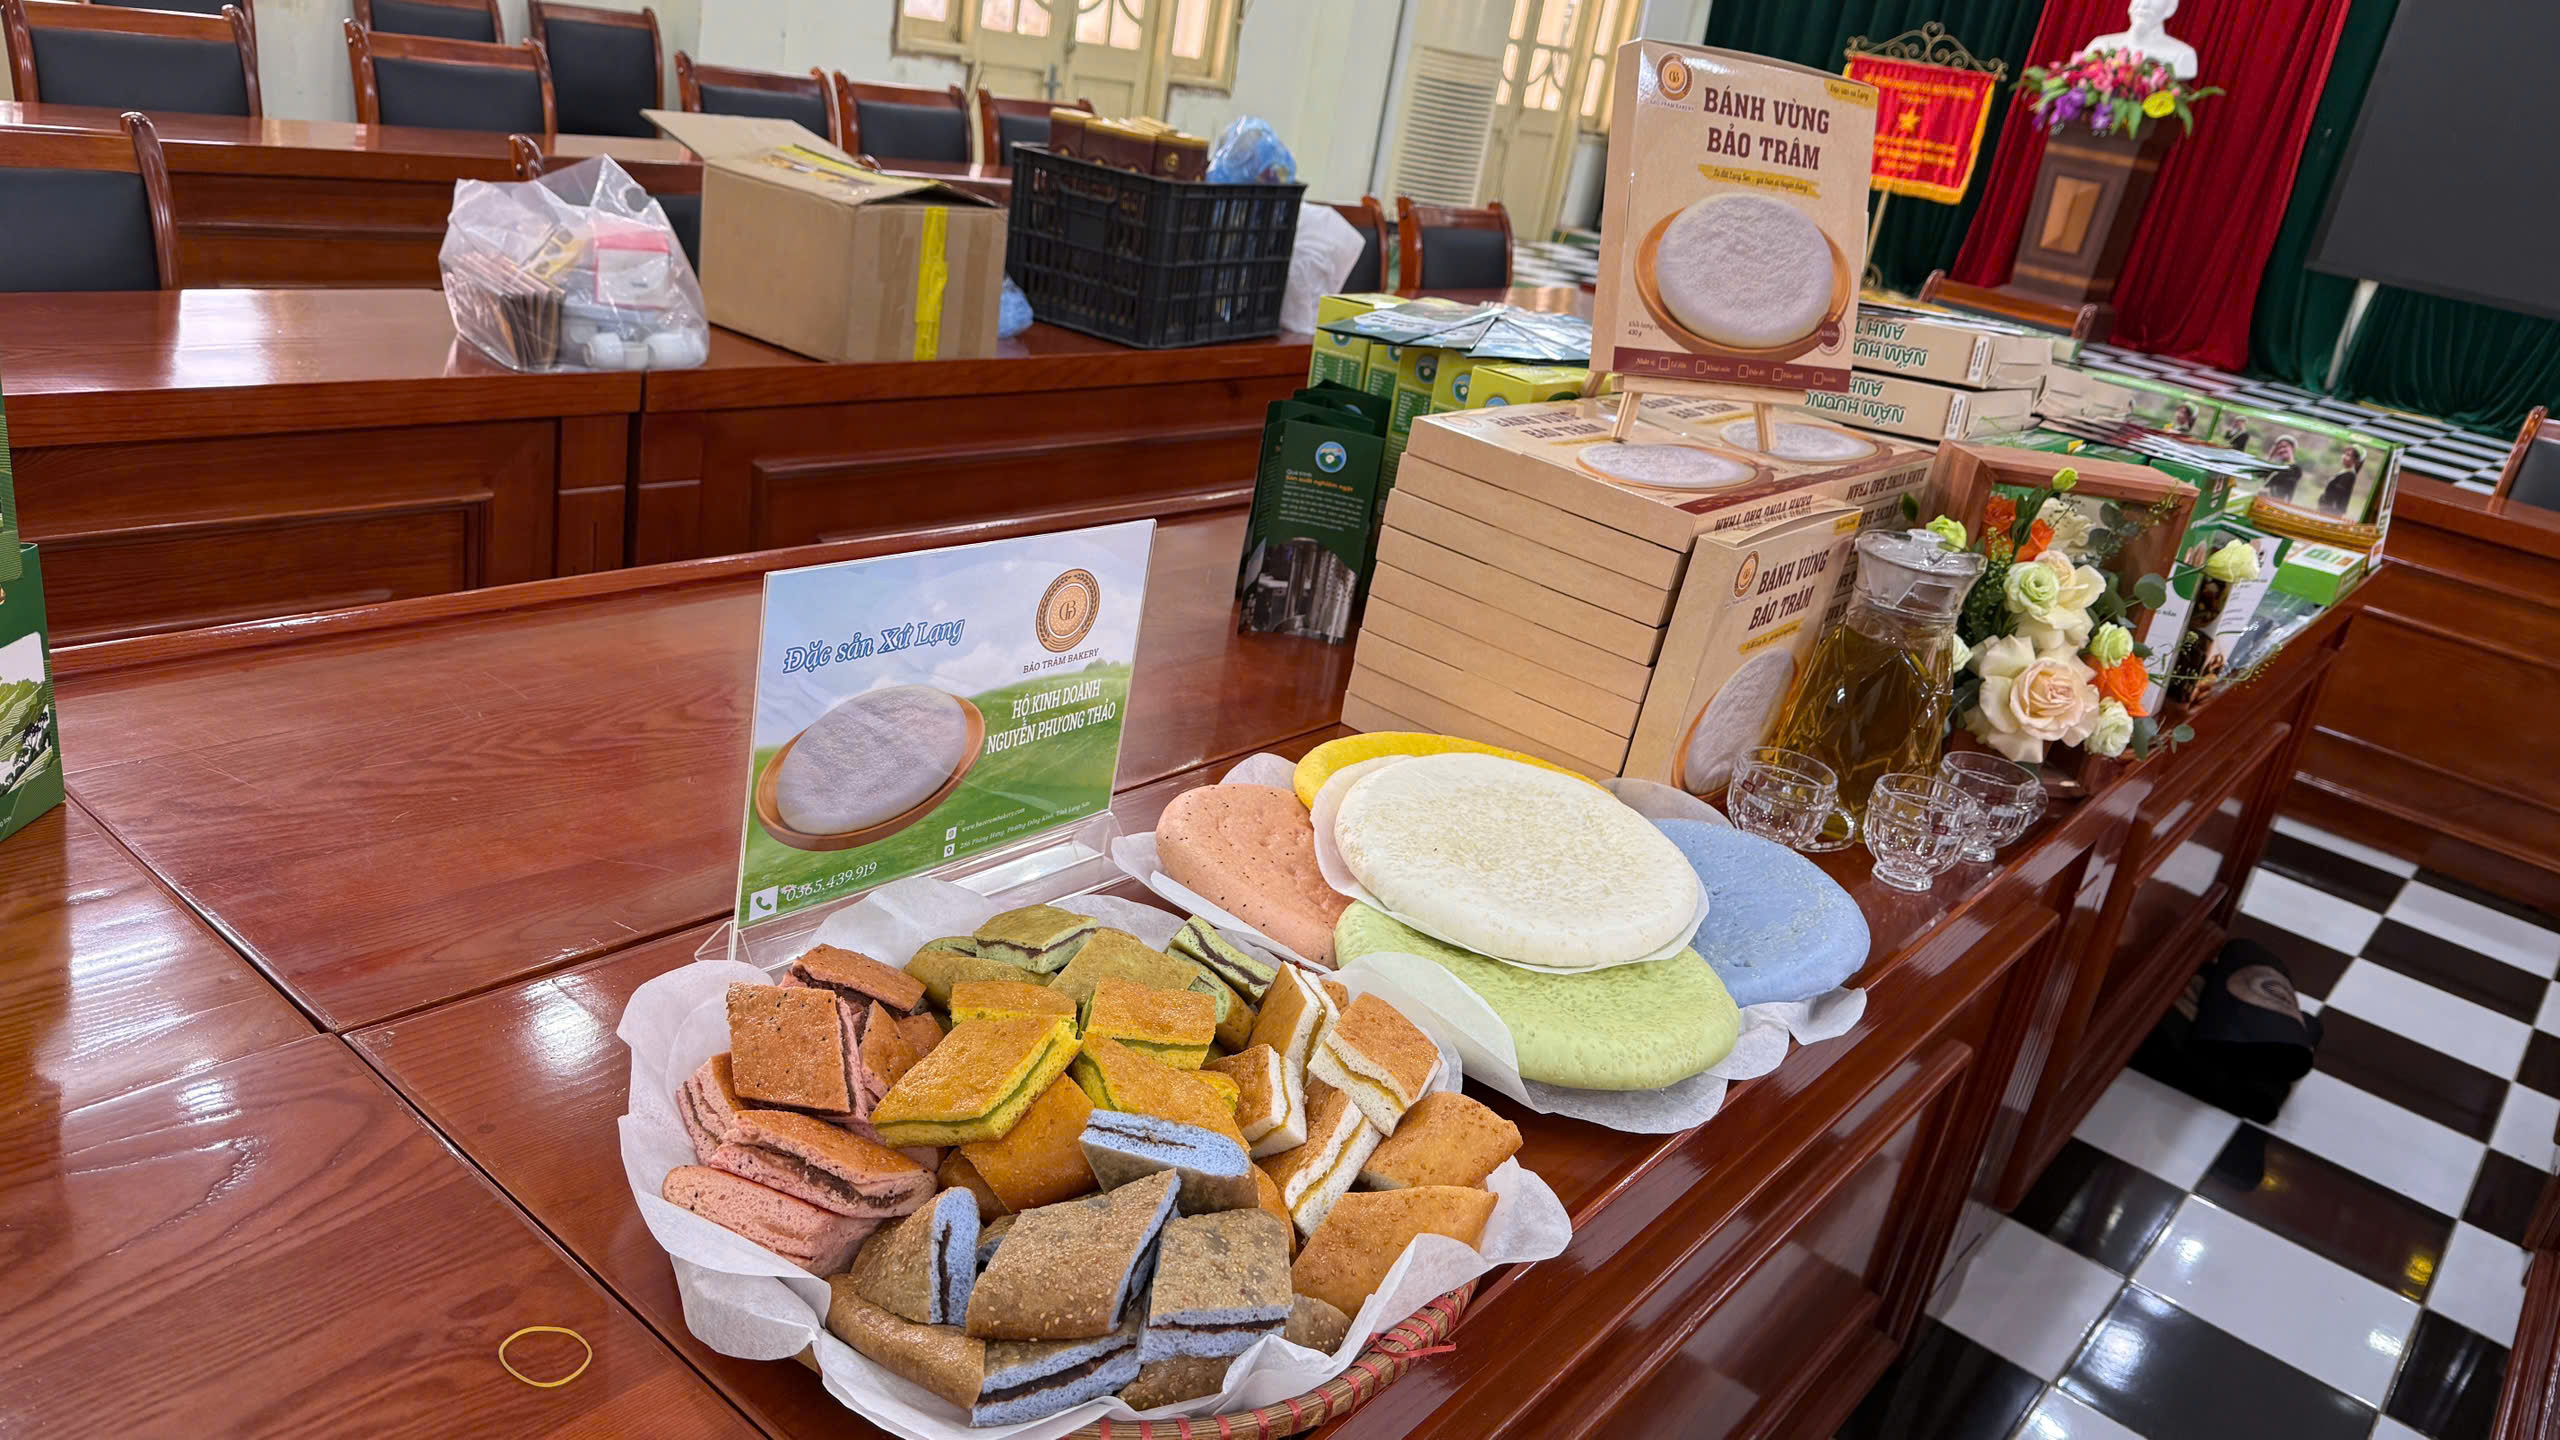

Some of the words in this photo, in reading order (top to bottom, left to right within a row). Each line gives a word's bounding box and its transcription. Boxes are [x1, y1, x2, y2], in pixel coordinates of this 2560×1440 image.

[1703, 85, 1766, 122] BÁNH
[1773, 98, 1831, 135] VỪNG
[1706, 123, 1751, 158] BẢO
[1759, 137, 1821, 171] TRÂM
[1884, 345, 1928, 369] NẤM
[1863, 404, 1905, 425] NẤM
[1757, 561, 1796, 596] BÁNH
[1748, 595, 1778, 631] BẢO
[1778, 584, 1815, 619] TRÂM
[783, 640, 833, 674] Đặc
[835, 632, 874, 663] sản
[877, 623, 914, 655] Xứ
[914, 619, 966, 647] Lạng
[1067, 648, 1100, 663] BAKERY
[1011, 692, 1030, 719] HỘ
[1029, 687, 1062, 715] KINH
[1061, 679, 1102, 707] DOANH
[986, 718, 1036, 755] NGUYỄN
[1037, 707, 1085, 741] PHƯƠNG
[1086, 698, 1117, 726] THẢO
[785, 861, 878, 902] 0365.439.919
